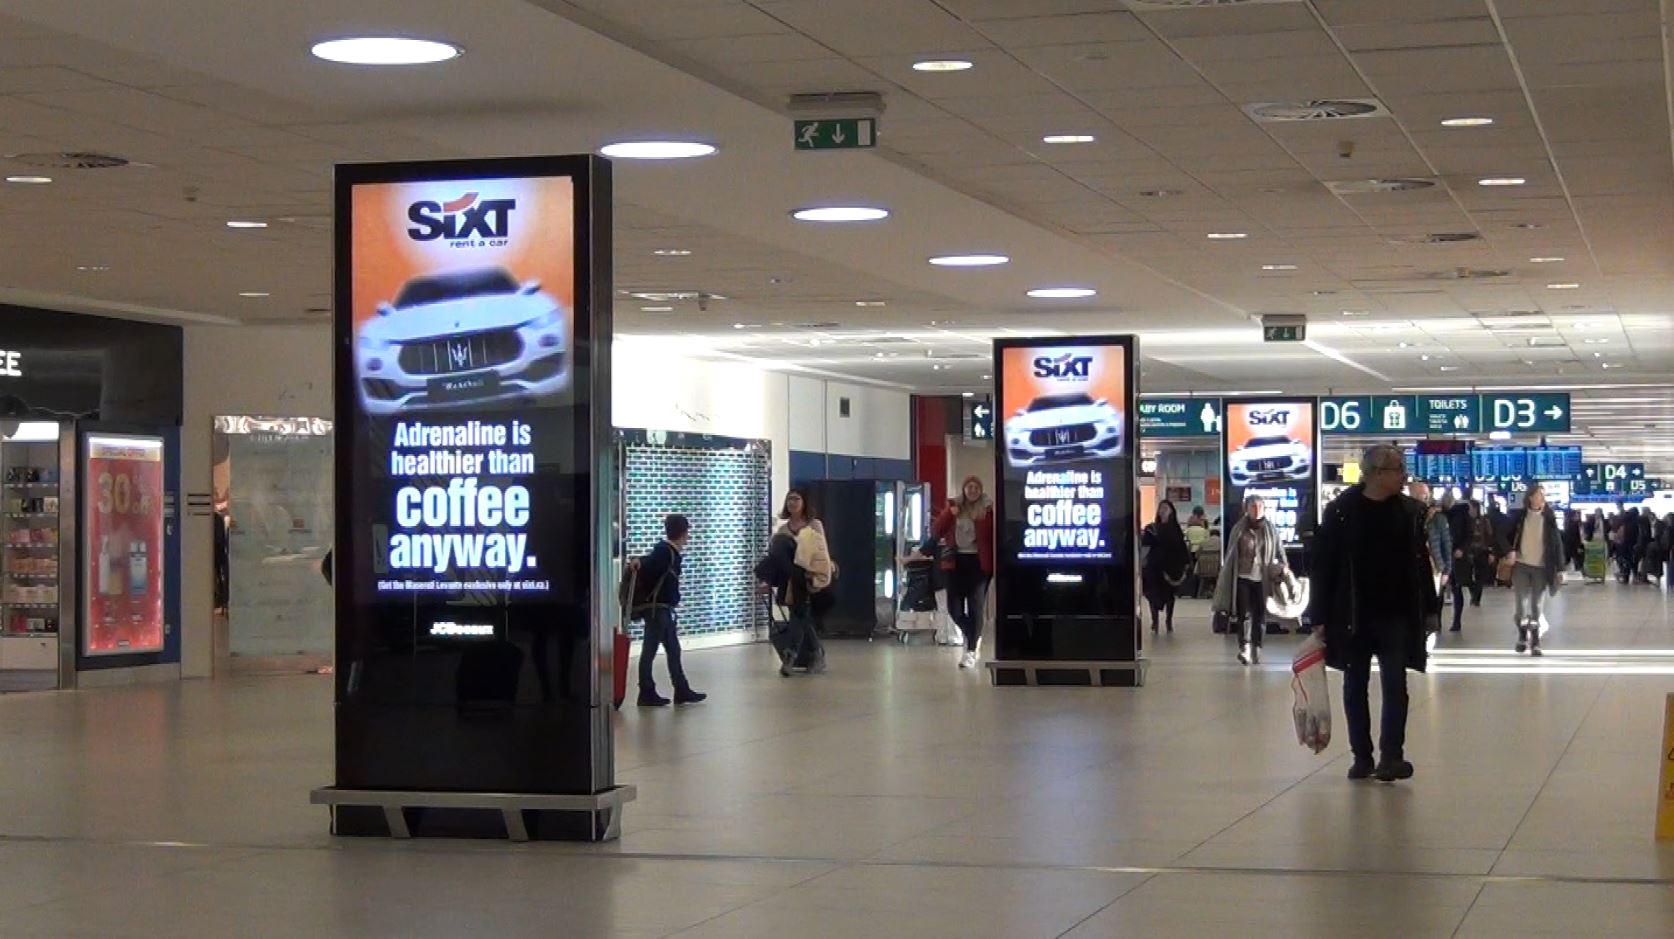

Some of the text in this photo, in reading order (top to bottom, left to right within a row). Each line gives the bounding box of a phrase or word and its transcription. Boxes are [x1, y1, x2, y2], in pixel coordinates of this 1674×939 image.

[450, 240, 475, 248] rent
[1159, 403, 1185, 413] ROOM
[1320, 399, 1536, 429] D6 TOILETS D3
[393, 420, 532, 447] Adrenaline is
[391, 449, 535, 475] healthier than
[1605, 464, 1627, 480] D4
[1026, 470, 1102, 485] Adrenaline is
[396, 477, 531, 528] coffee
[1027, 499, 1102, 527] coffee
[1024, 528, 1105, 550] anyway.
[389, 532, 537, 574] anyway.
